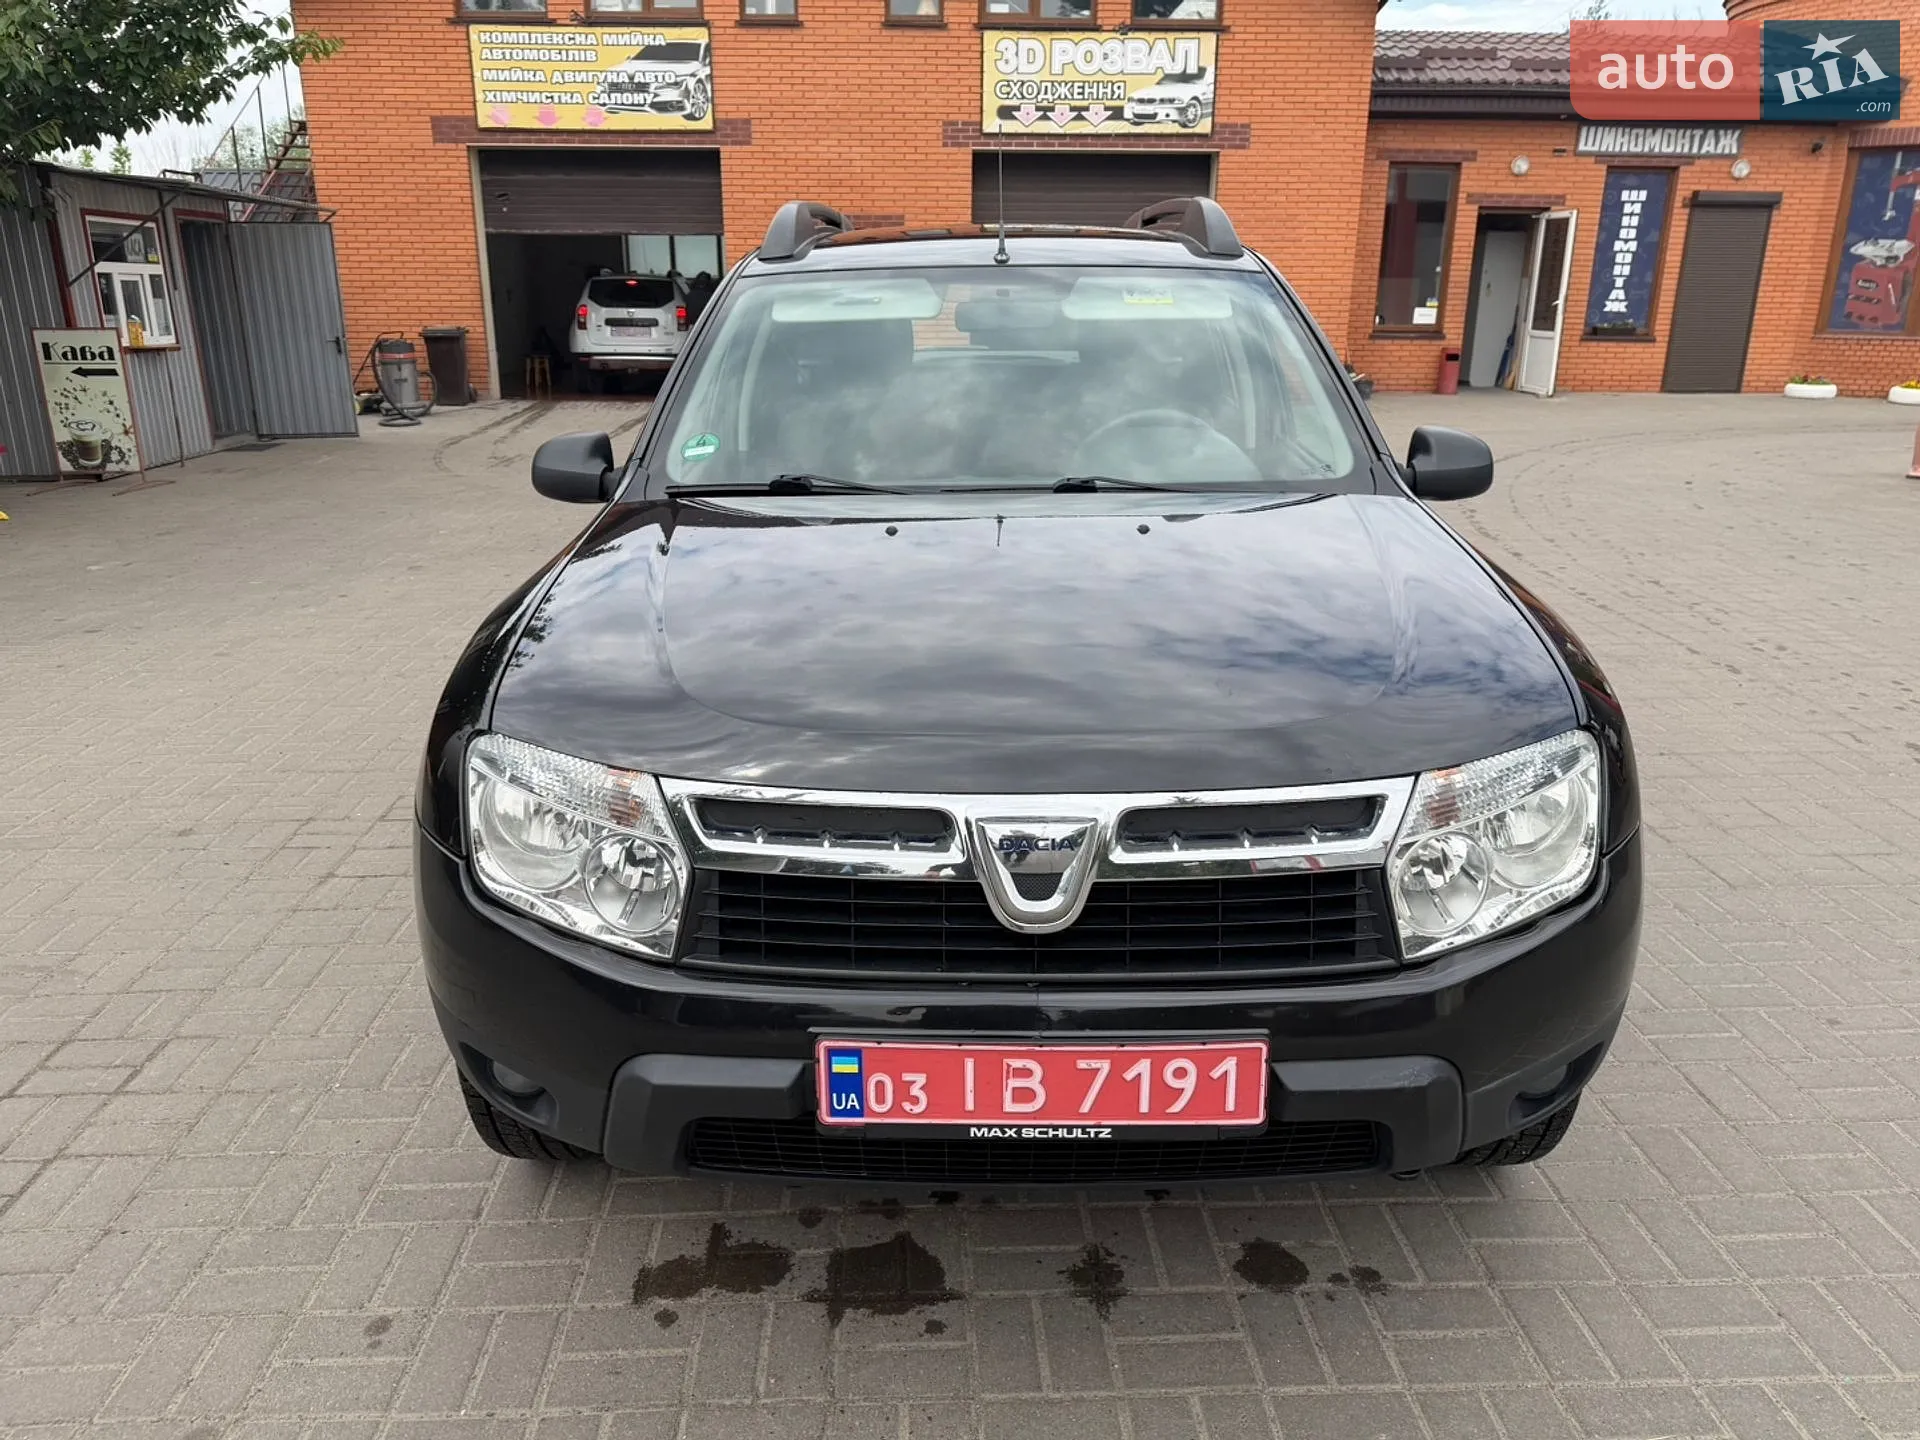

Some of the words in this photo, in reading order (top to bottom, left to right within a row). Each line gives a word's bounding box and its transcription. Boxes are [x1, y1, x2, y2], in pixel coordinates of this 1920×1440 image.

[479, 31, 598, 46] КОМПЛЕКСНА
[602, 32, 666, 47] МИЙКА
[480, 48, 598, 62] АВТОМОБІЛІВ
[994, 37, 1046, 75] 3D
[1050, 37, 1201, 76] РОЗВАЛ
[482, 68, 546, 83] МИЙКА
[551, 70, 629, 84] ДВИГУНА
[634, 70, 677, 83] АВТО
[482, 91, 583, 105] ХІМЧИСТКА
[588, 92, 656, 106] САЛОНУ
[994, 80, 1127, 102] СХОДЖЕННЯ
[1579, 125, 1742, 155] ШИНОМОНТАЖ
[1603, 189, 1648, 313] ШИНОМОНТАЖ
[41, 342, 116, 361] Кава
[999, 837, 1075, 852] DACIA
[866, 1072, 929, 1114] 03
[1075, 1056, 1238, 1114] 7191
[832, 1093, 860, 1110] UA
[969, 1126, 1018, 1138] MAX
[1021, 1127, 1113, 1138] SCHULTZ
